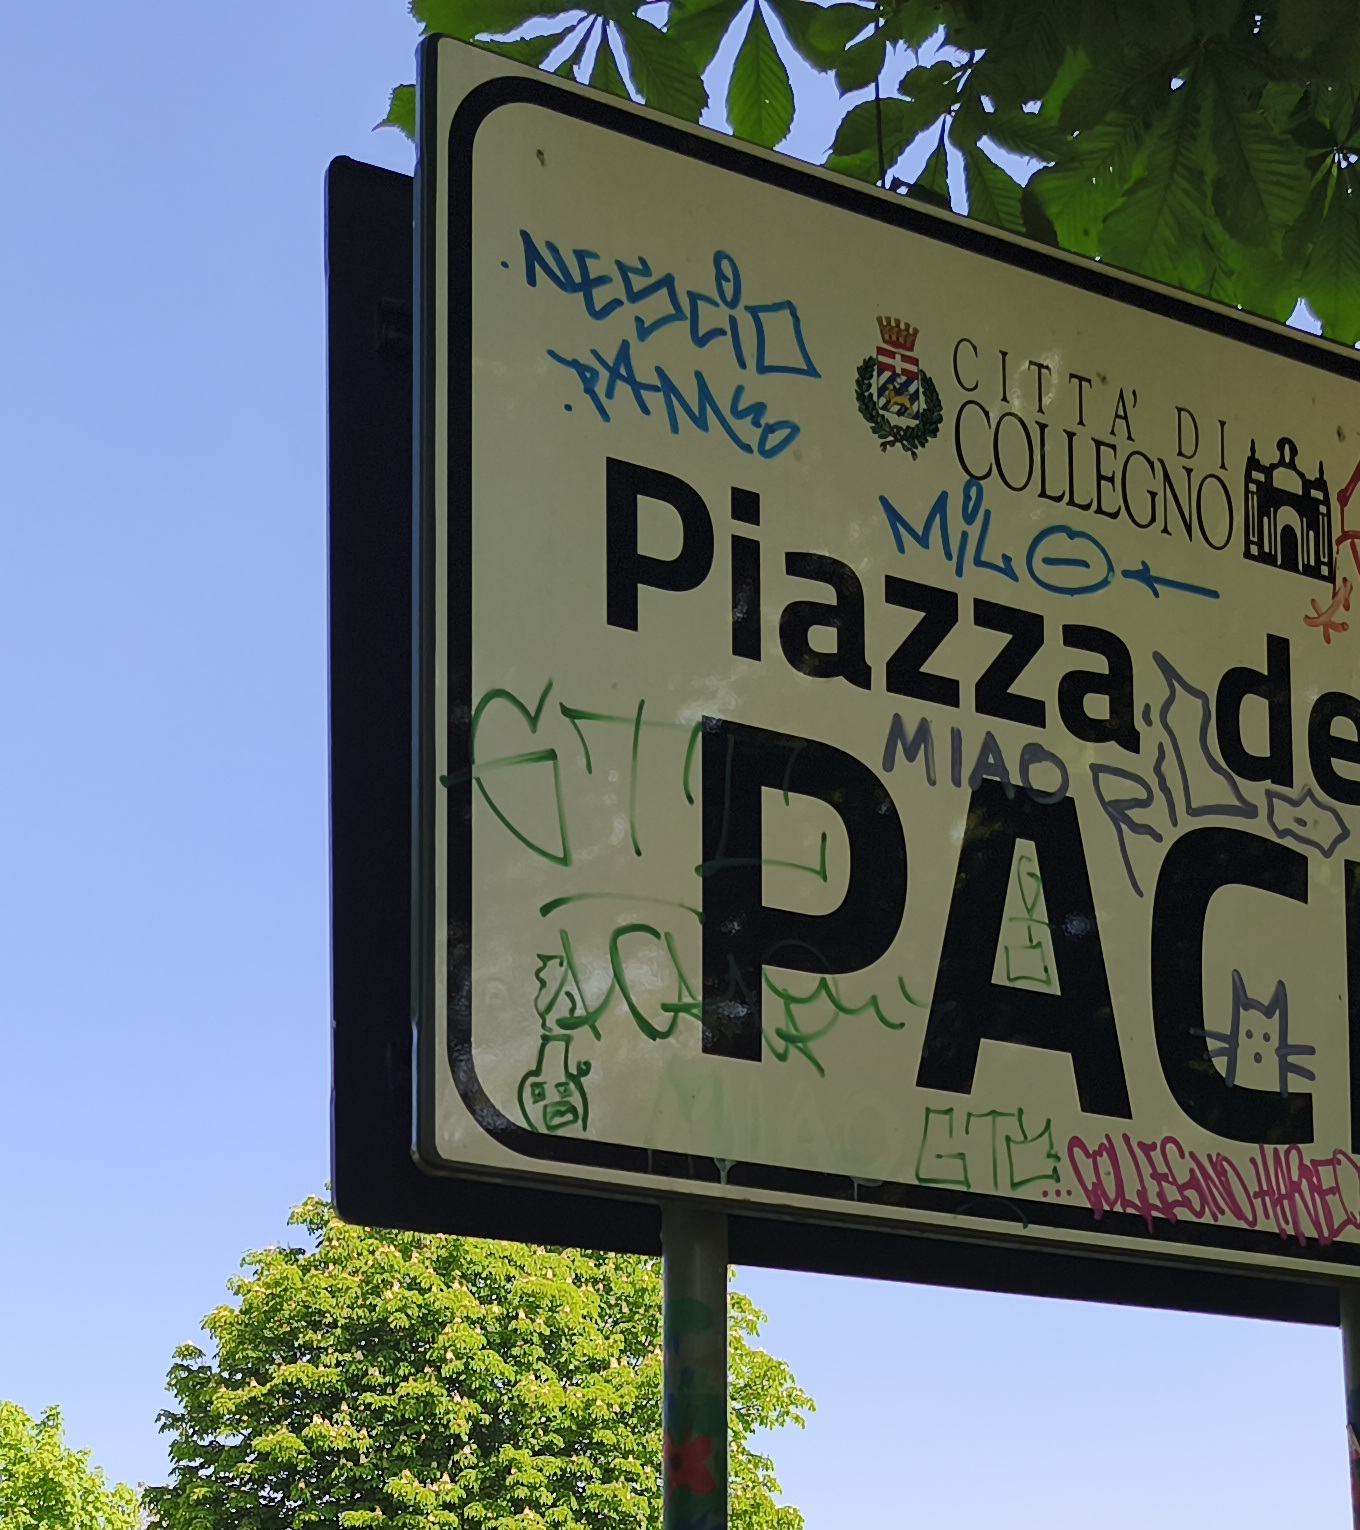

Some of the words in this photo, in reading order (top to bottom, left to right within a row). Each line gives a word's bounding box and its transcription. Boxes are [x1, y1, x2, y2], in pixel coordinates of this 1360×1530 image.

[954, 400, 1234, 551] COLLEGNO
[1175, 406, 1228, 471] DI
[606, 457, 1140, 754] Piazza
[882, 712, 1070, 804] MIAO
